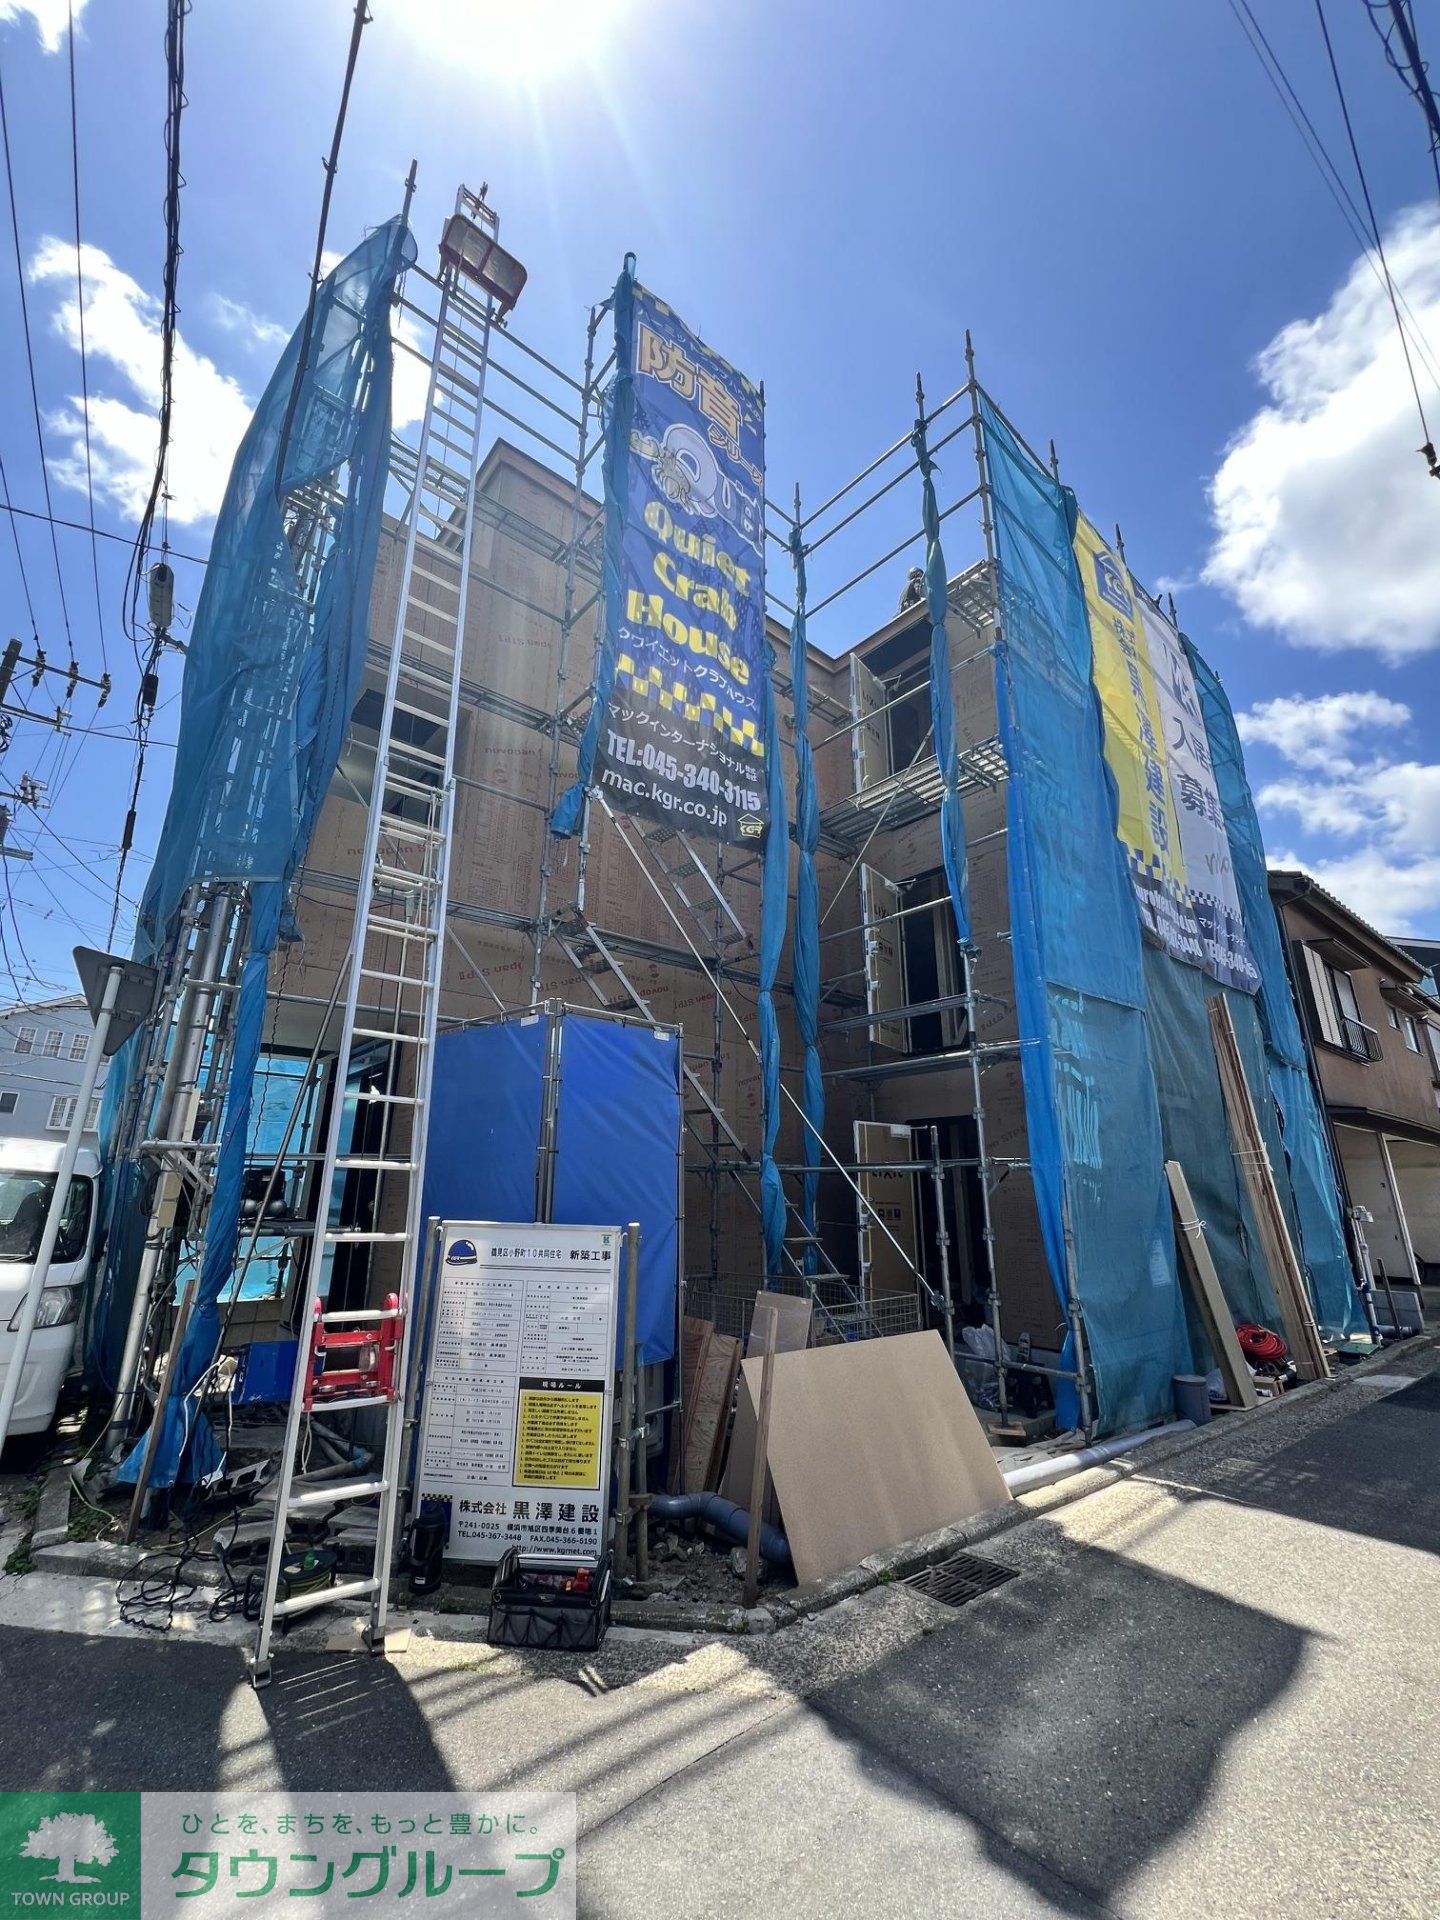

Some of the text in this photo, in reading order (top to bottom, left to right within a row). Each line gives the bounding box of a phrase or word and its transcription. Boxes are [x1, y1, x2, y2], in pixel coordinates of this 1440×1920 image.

[644, 501, 752, 597] Quiet
[653, 552, 738, 631] Crab
[627, 589, 750, 686] House
[601, 769, 727, 826] mac.kgr.co.jp
[607, 729, 762, 811] TEL:045-340-3115
[569, 1249, 611, 1262] 新築工事
[459, 1499, 600, 1523] 株式会社 黒澤建設
